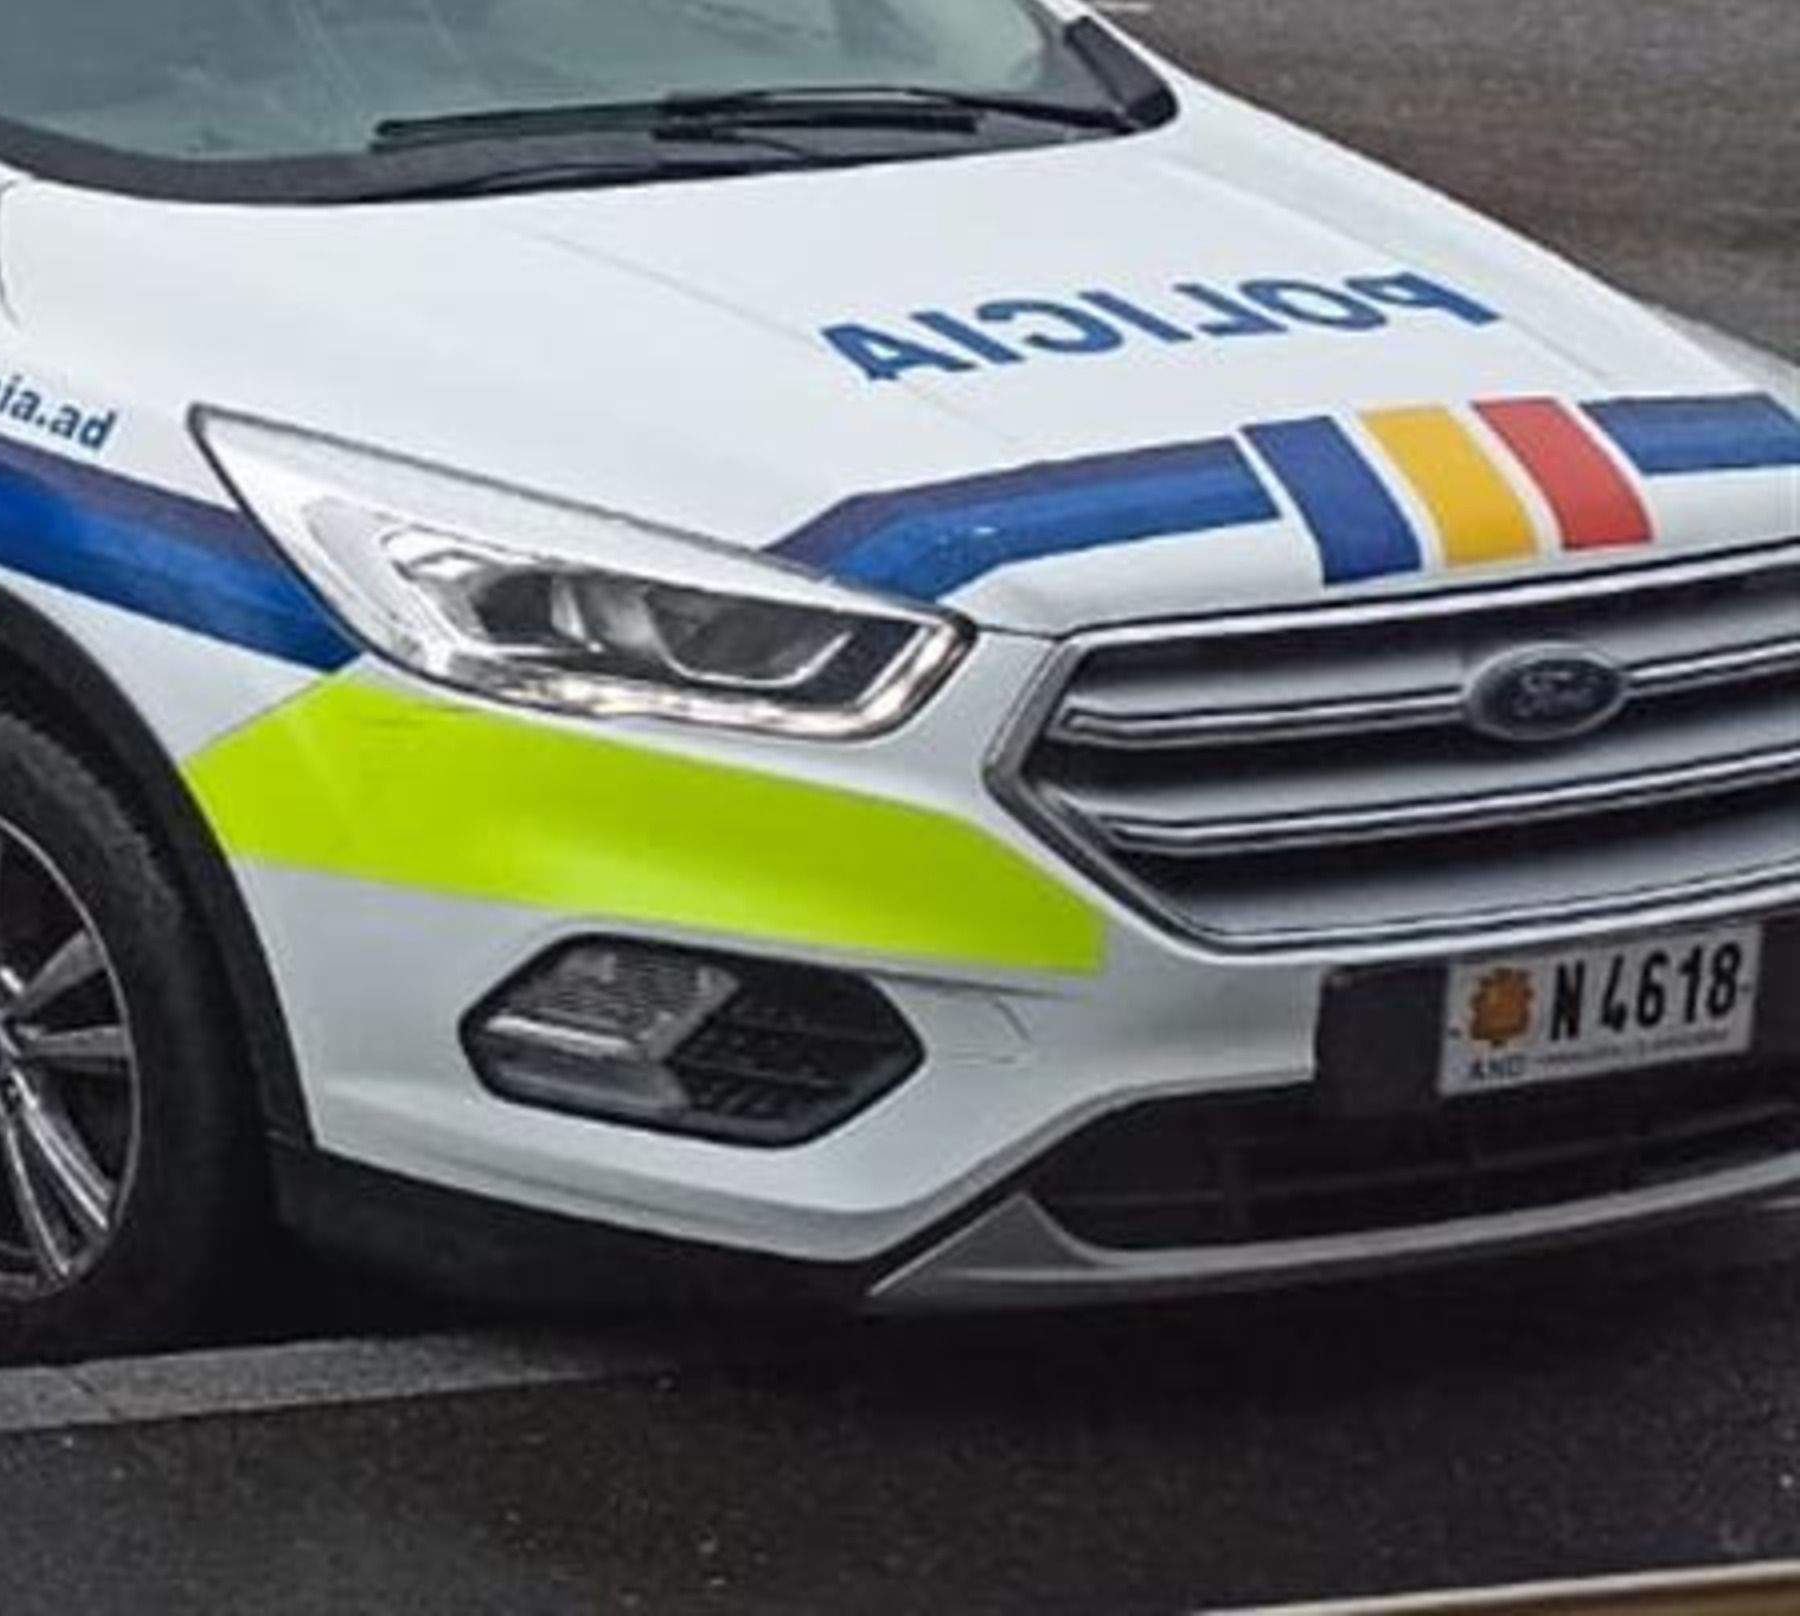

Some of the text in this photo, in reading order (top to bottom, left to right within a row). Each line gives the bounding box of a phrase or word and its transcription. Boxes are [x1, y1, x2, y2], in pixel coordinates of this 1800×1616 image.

[1512, 670, 1600, 719] Ford
[1549, 941, 1743, 1042] N 4618
